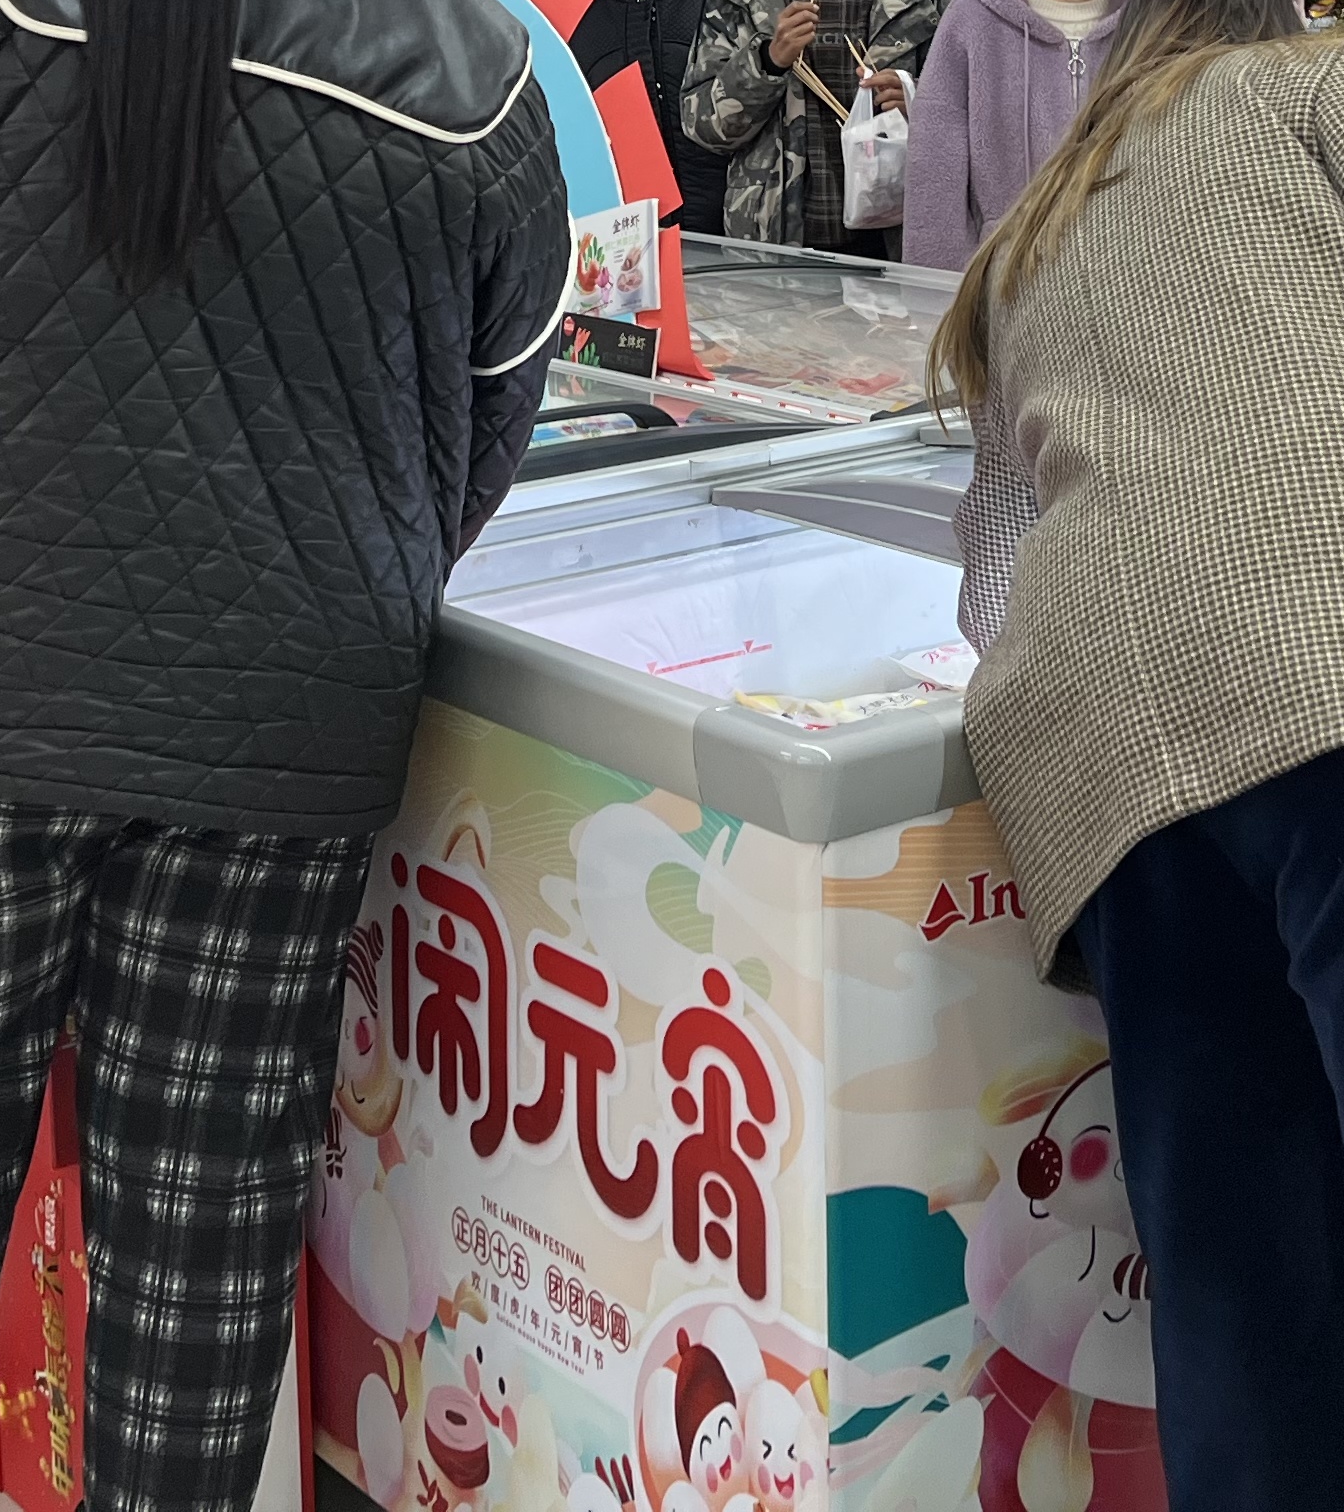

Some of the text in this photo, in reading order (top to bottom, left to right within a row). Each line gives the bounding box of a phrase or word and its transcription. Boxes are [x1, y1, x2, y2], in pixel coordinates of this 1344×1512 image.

[391, 852, 775, 1301] 闹元宵
[481, 1195, 587, 1273] THE LANTERN FESTIVAL
